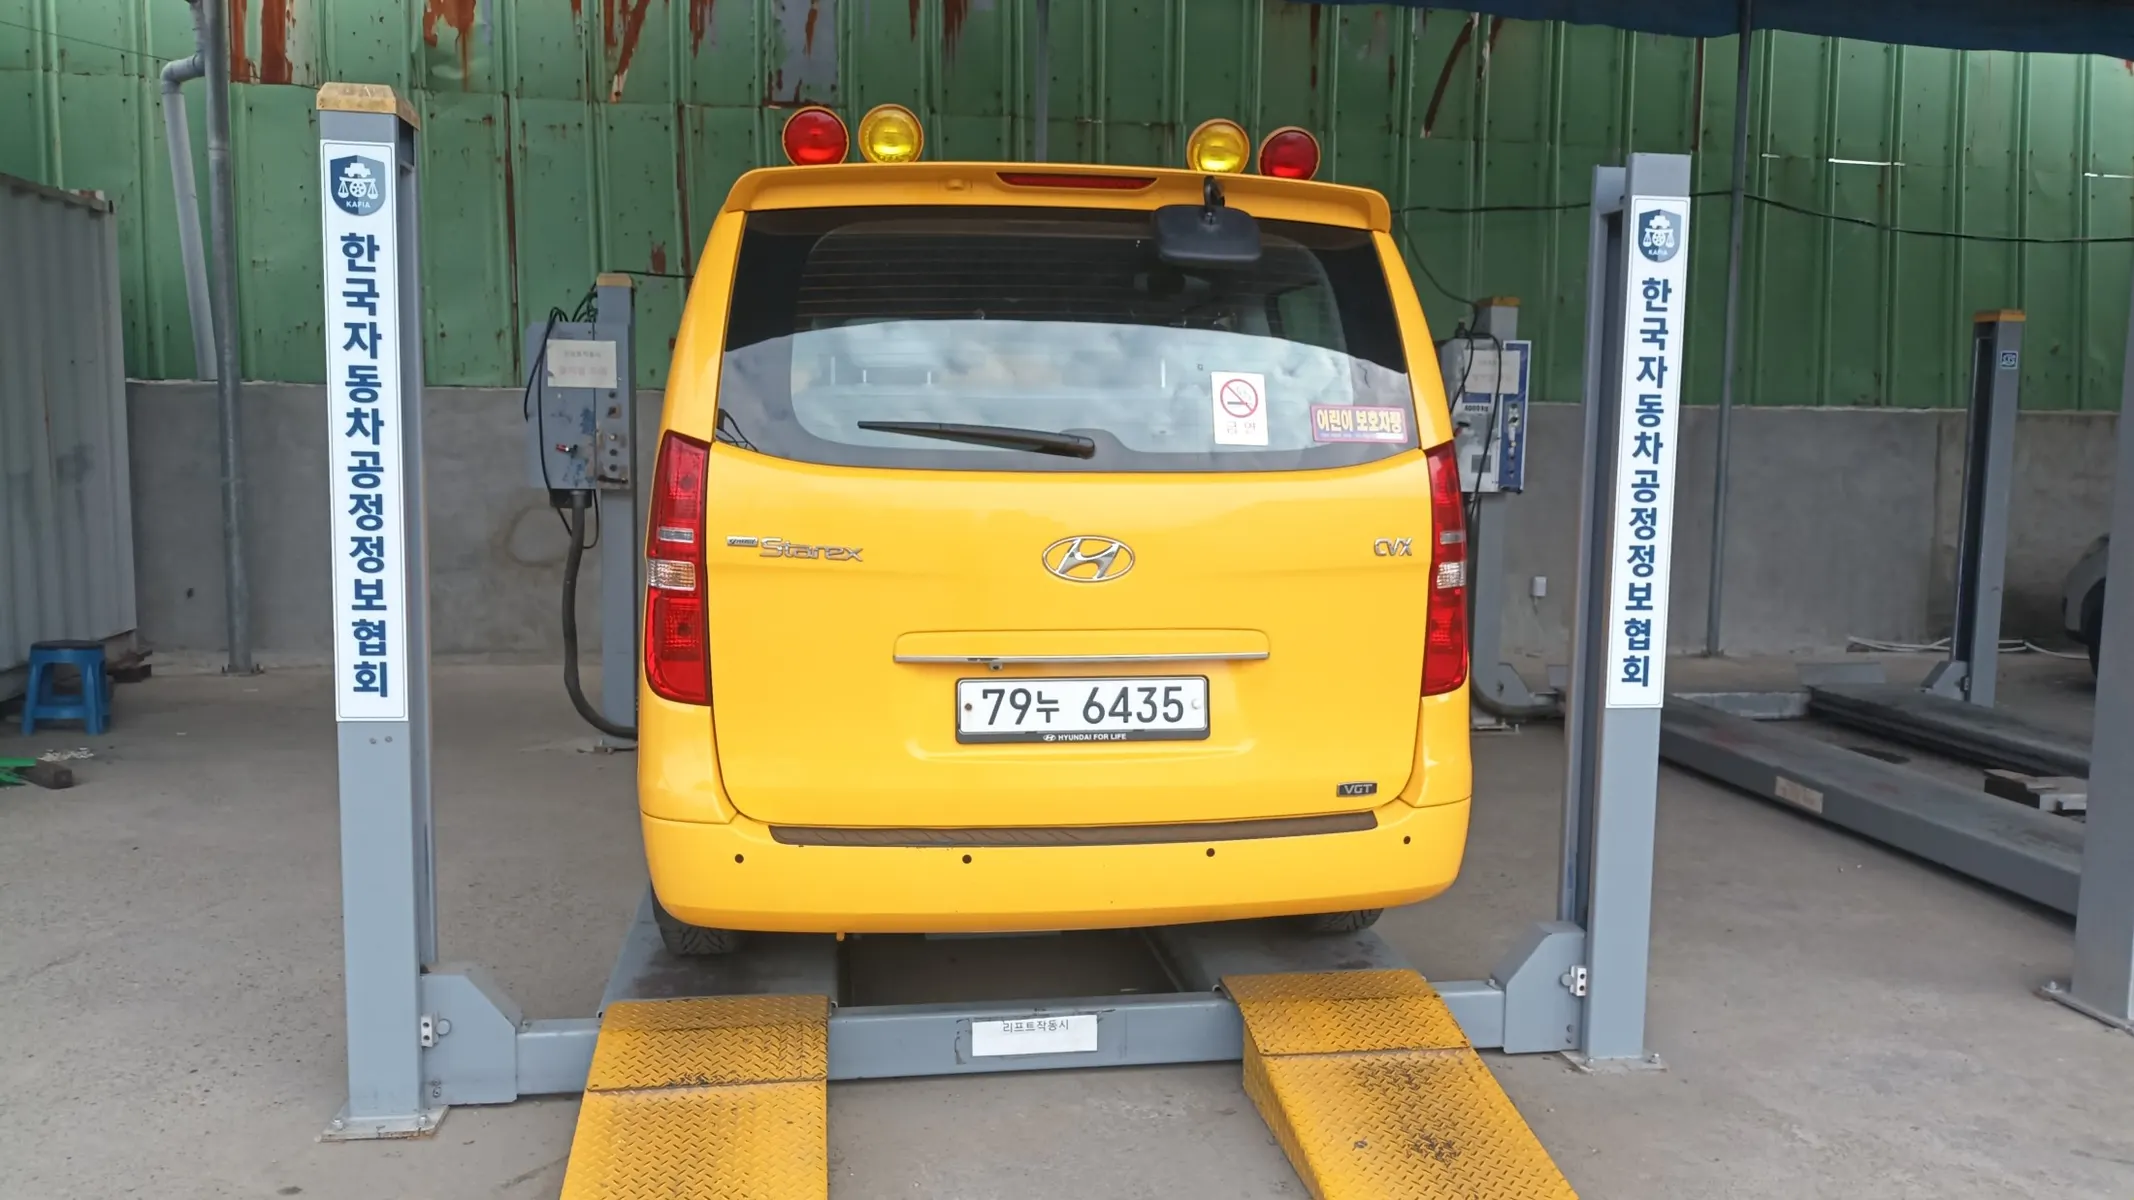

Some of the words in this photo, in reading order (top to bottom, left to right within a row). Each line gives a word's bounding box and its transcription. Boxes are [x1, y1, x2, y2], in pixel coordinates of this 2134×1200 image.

[345, 200, 371, 209] KAFIA
[1316, 409, 1353, 432] 어린이
[1356, 410, 1403, 433] 보호차량
[340, 232, 388, 698] 한국자동차공정정보협회
[1621, 277, 1672, 687] 한국자동차공정정보협회
[760, 537, 864, 562] Starex
[1374, 537, 1412, 556] CVX
[982, 688, 1060, 726] 79누
[1082, 686, 1184, 724] 6435
[1058, 733, 1092, 741] HYUNDAI
[1344, 784, 1373, 794] VGT
[1003, 1019, 1069, 1033] 리프트작동시
